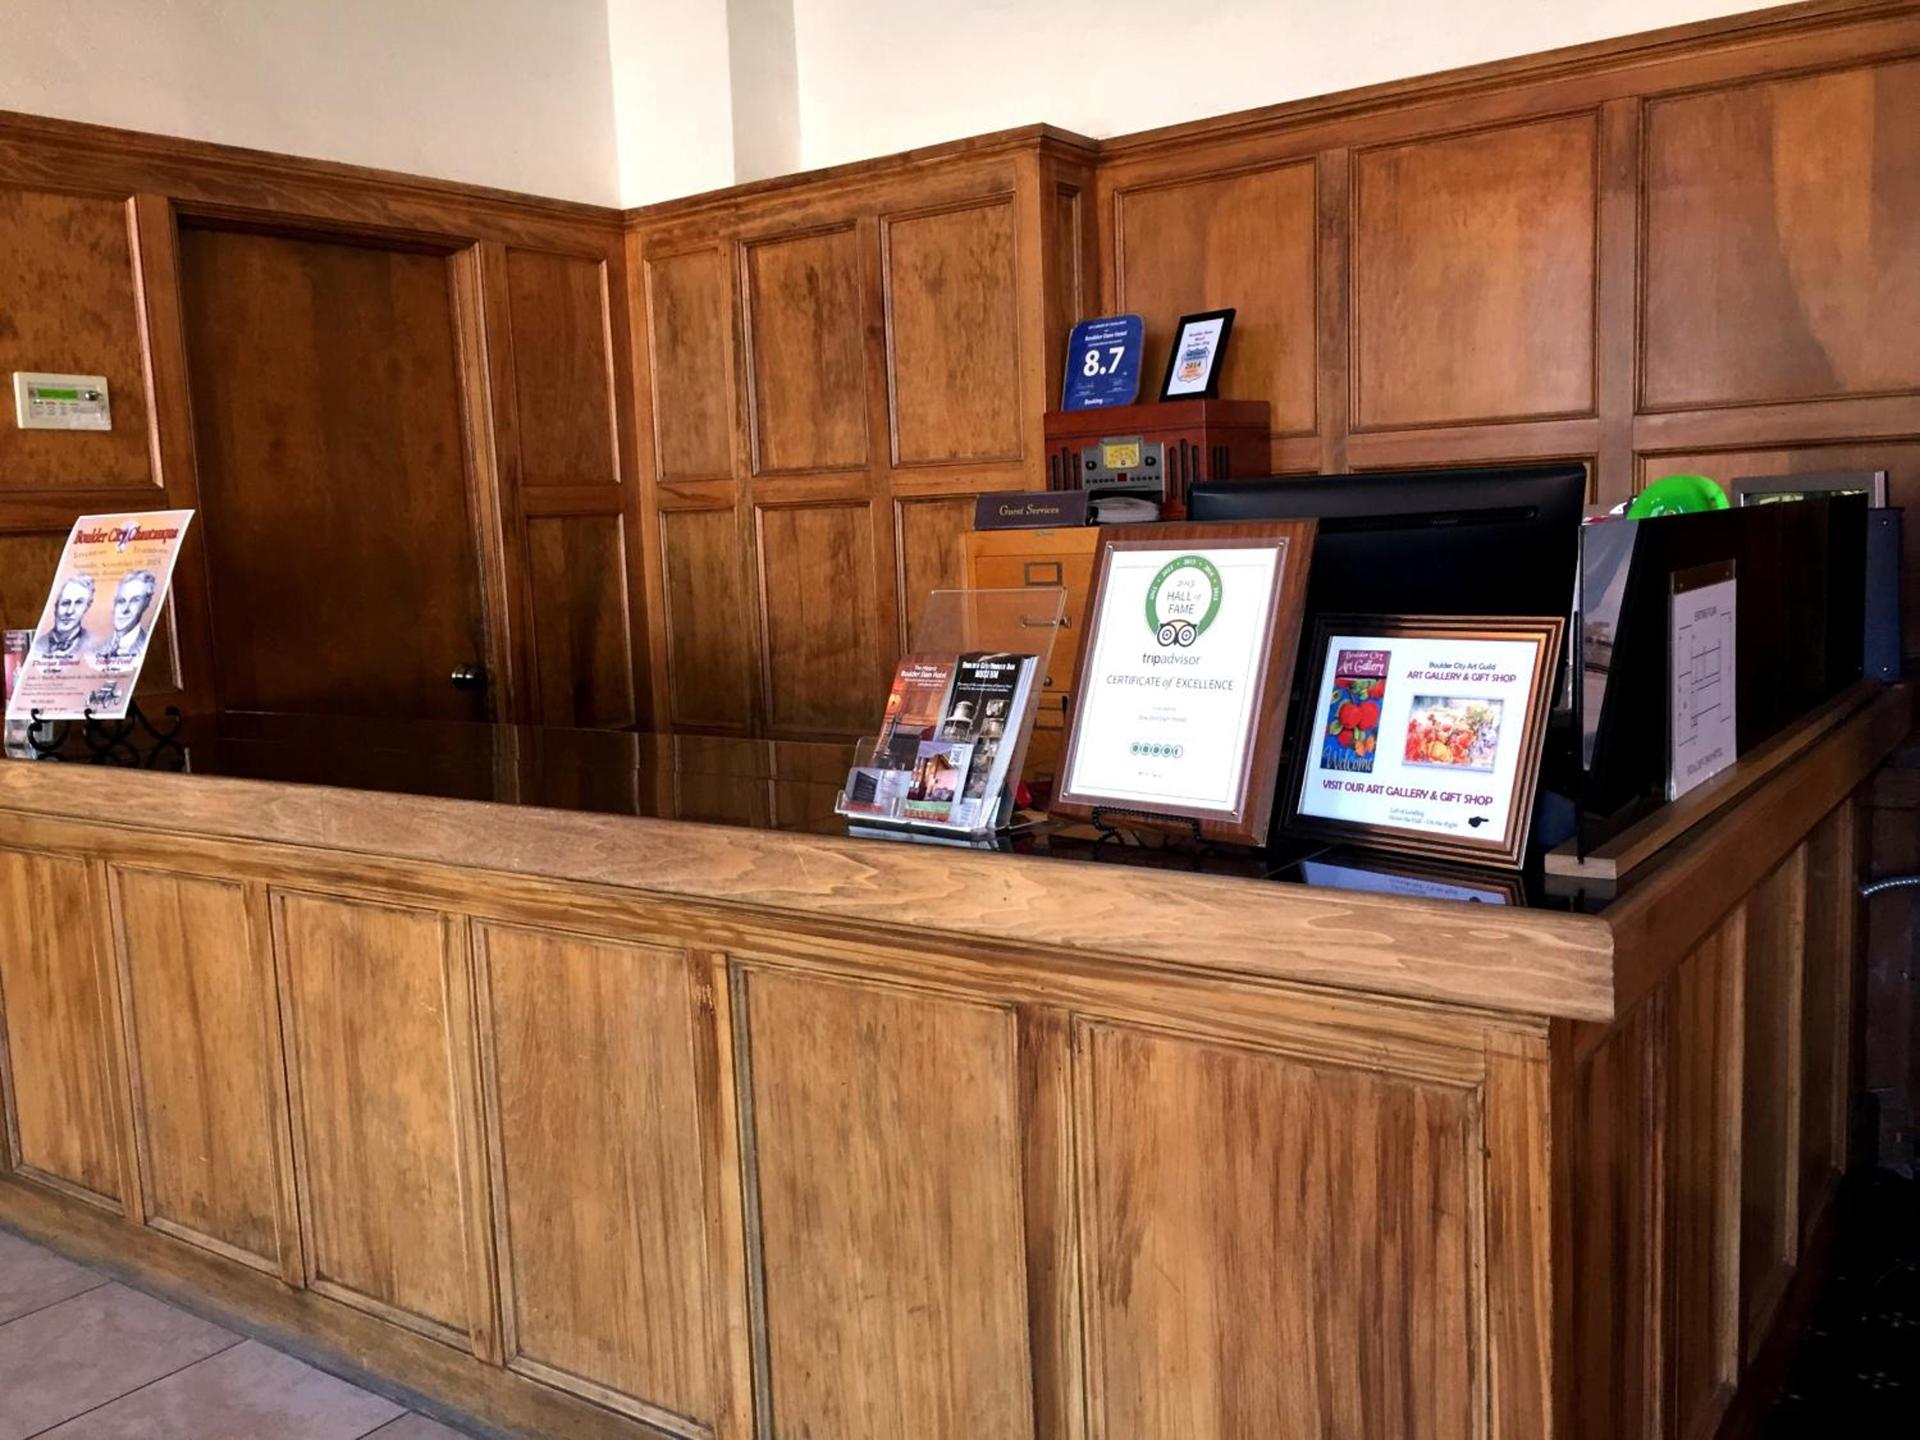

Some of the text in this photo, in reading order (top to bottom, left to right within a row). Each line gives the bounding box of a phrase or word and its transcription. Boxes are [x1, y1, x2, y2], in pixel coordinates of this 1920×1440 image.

[1083, 346, 1125, 377] 8.7
[999, 504, 1060, 516] Guest Services
[73, 528, 107, 544] Boulder
[1167, 591, 1192, 601] HALL
[1168, 603, 1196, 614] FAME
[1142, 652, 1201, 667] tripadvisor
[1338, 659, 1385, 675] Art Gallery
[1453, 662, 1466, 671] City
[1106, 674, 1233, 690] CERTIFICATE of EXCELLENCE
[1407, 670, 1517, 683] ART GALLERY & GIFT SHOP
[1322, 745, 1373, 771] Welcome
[1322, 779, 1493, 806] VISIT OUR ART GALLERY & GIFT SHOP
